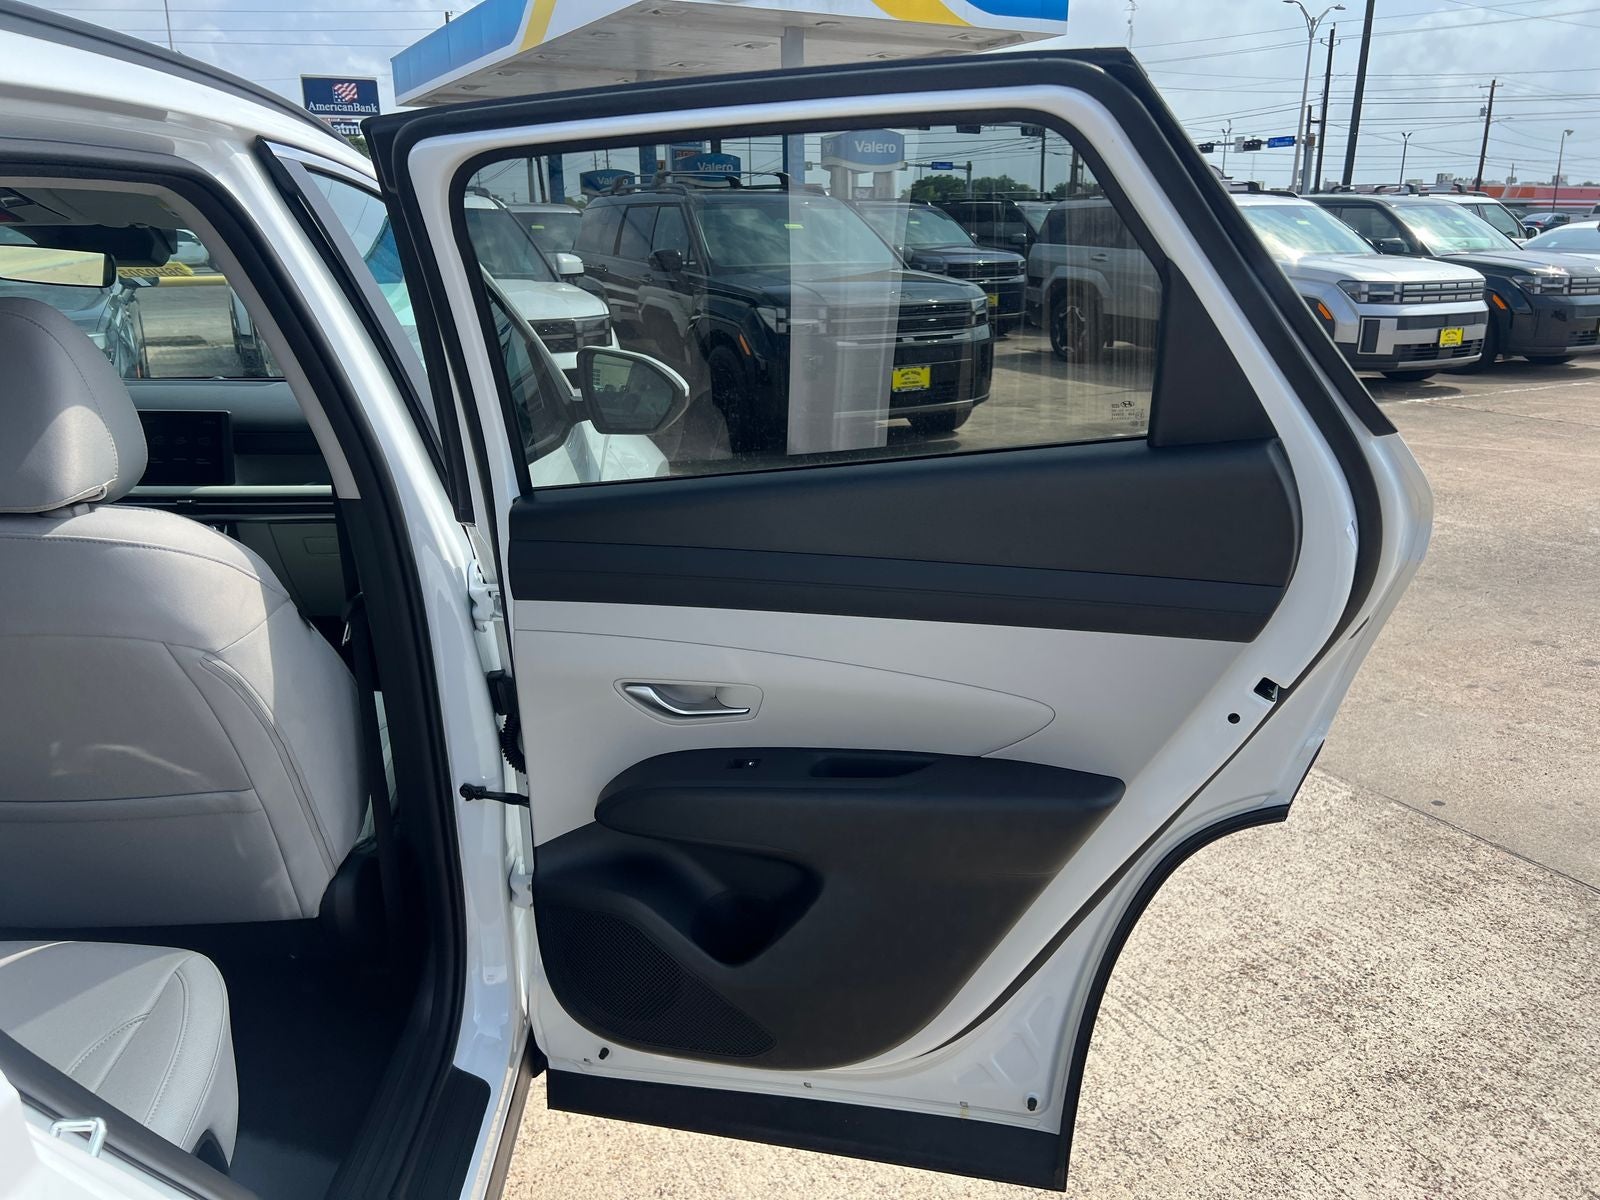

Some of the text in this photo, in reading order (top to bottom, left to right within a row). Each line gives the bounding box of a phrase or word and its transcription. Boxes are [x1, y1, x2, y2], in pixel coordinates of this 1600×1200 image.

[308, 101, 378, 113] AmericanBank
[333, 122, 359, 135] atm
[855, 140, 897, 153] Valero
[697, 161, 734, 172] Valero
[597, 176, 629, 185] Valo
